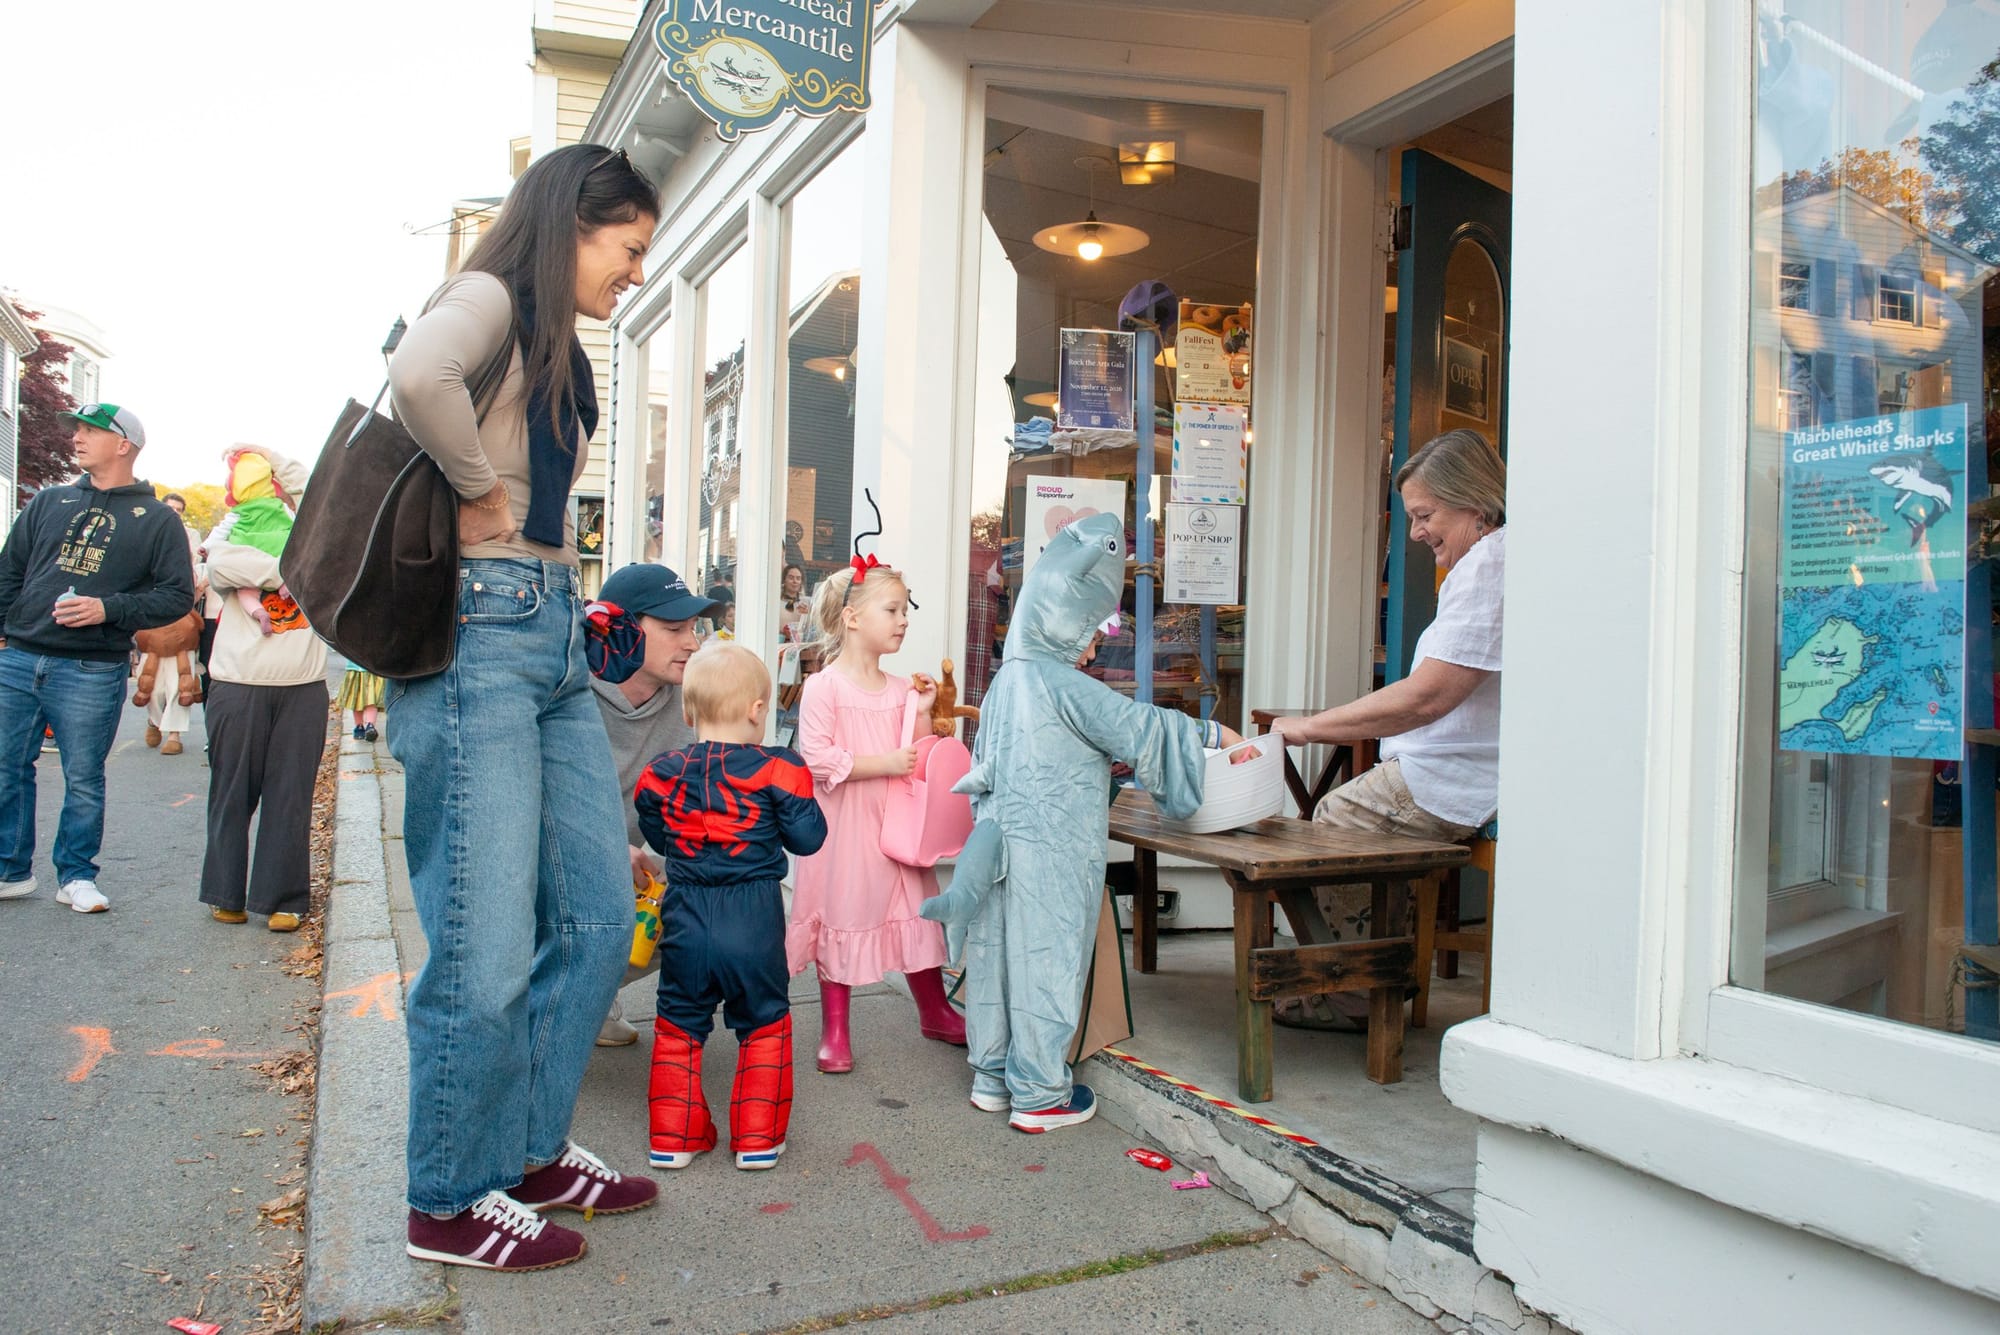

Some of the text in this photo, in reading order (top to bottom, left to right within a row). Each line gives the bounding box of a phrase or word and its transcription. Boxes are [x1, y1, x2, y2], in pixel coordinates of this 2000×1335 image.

[690, 0, 854, 62] Mercantile
[1184, 335, 1214, 345] FallFest
[1450, 363, 1483, 391] OPEN
[1069, 383, 1100, 391] November
[1793, 419, 1893, 447] Marblehead's
[1793, 429, 1955, 463] Great White Sharks
[1207, 536, 1232, 544] SHOP
[1787, 678, 1834, 689] MARBLEHEAD
